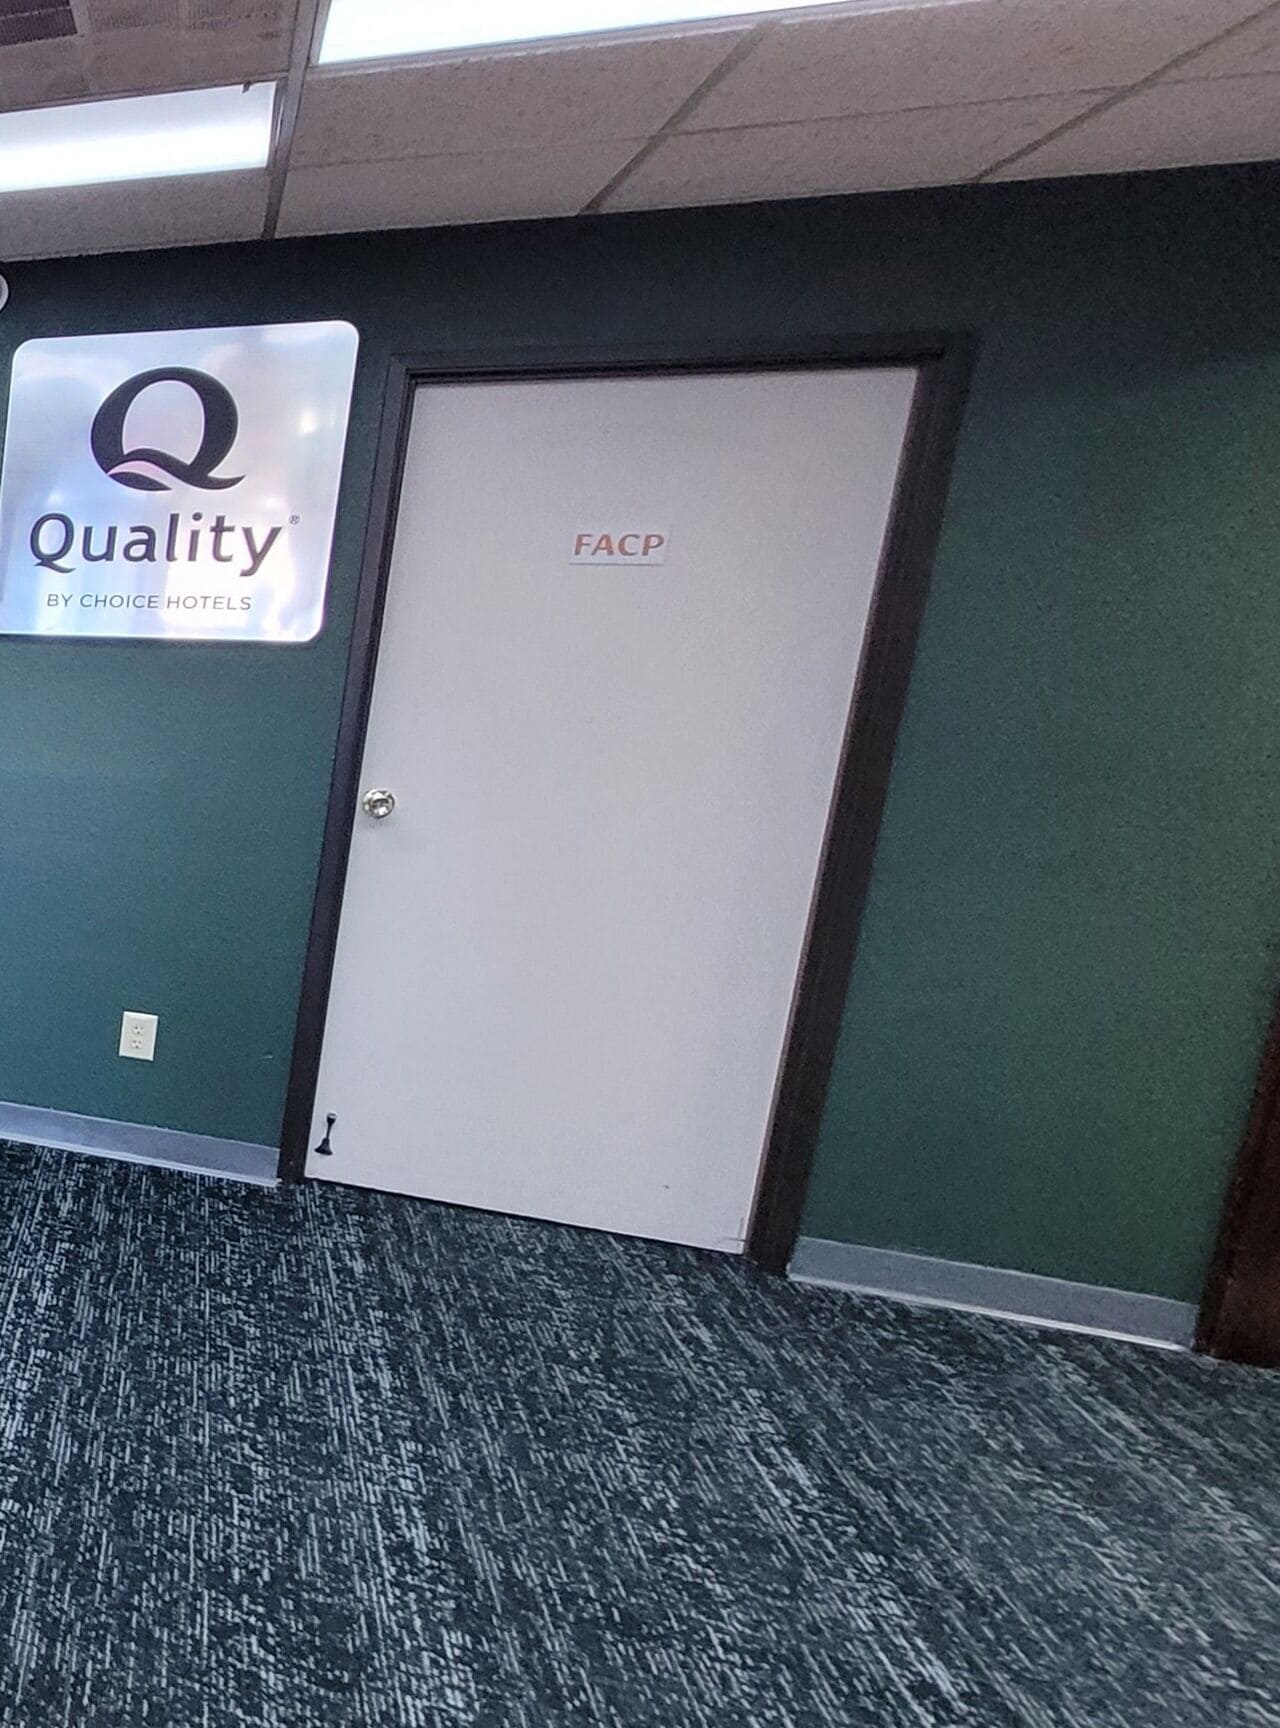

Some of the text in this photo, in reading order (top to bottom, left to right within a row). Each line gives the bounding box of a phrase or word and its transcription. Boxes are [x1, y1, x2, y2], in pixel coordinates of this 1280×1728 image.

[90, 366, 246, 491] Q
[30, 512, 283, 577] Quality
[574, 533, 665, 556] FACP
[47, 594, 252, 610] BY CHOICE HOTELS
